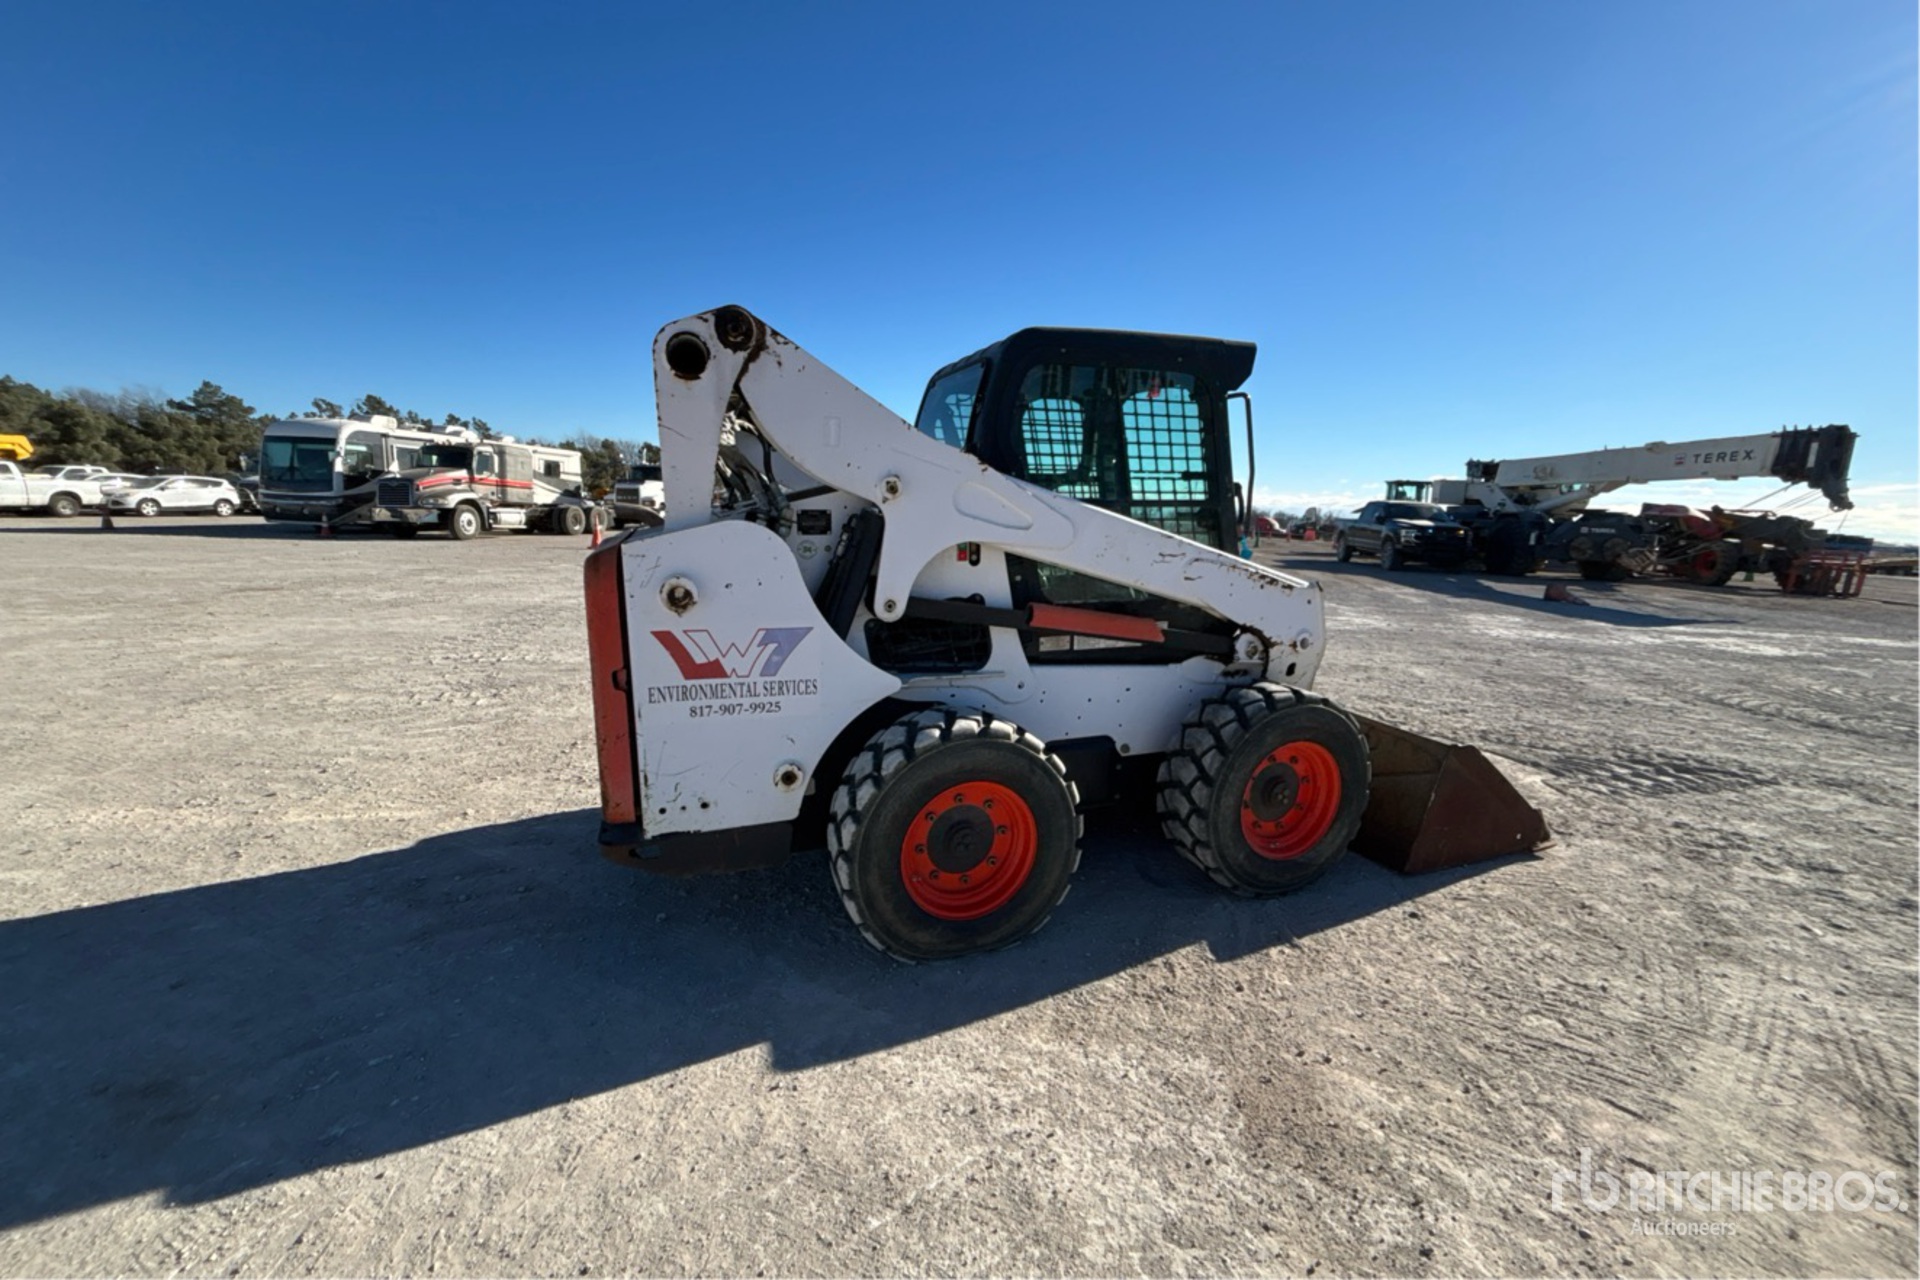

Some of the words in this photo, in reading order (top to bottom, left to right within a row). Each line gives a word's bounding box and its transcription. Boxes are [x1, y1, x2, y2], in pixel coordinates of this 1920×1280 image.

[1693, 449, 1754, 464] TEREX
[648, 682, 761, 704] ENVIRONMENTAL
[763, 679, 818, 697] SERVICES
[689, 701, 782, 718] 817-907-9925
